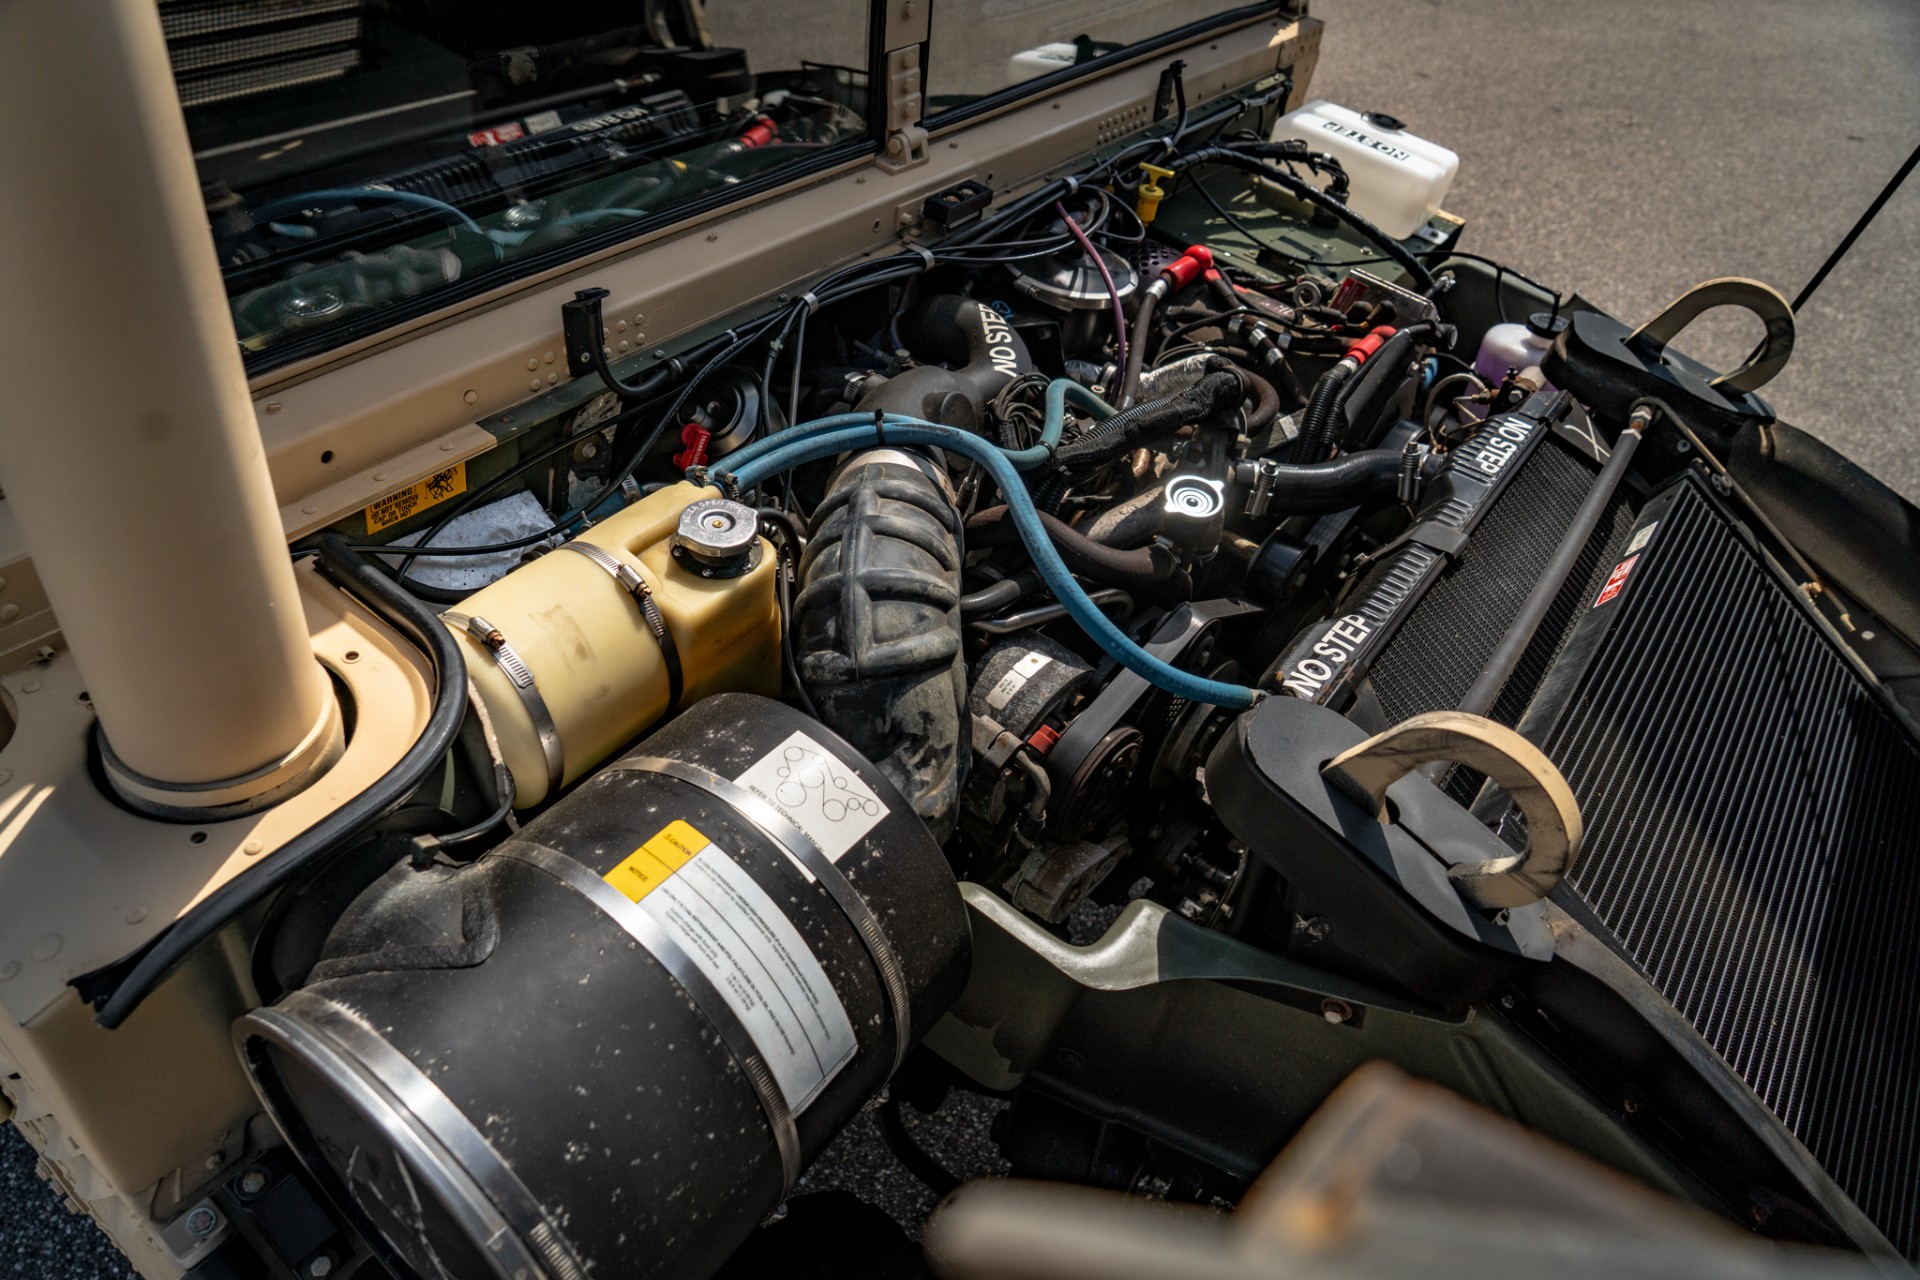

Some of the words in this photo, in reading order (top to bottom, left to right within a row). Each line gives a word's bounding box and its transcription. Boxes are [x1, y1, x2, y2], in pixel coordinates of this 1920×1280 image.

[978, 303, 1012, 344] STEP
[989, 346, 1018, 378] NO
[1498, 417, 1532, 441] NO
[1476, 437, 1517, 474] STEP
[371, 511, 380, 520] DO
[380, 505, 393, 515] NOT
[395, 494, 419, 509] REMOVE
[373, 487, 413, 510] WARNING
[374, 515, 386, 524] CAP
[388, 510, 397, 519] OR
[398, 501, 418, 515] TOUCH
[381, 515, 398, 526] WHEN
[400, 509, 411, 518] HOT
[1282, 659, 1332, 697] NO
[1313, 614, 1371, 662] STEP
[748, 784, 768, 800] REFER
[767, 797, 776, 807] TO
[668, 837, 692, 856] CAUTION
[628, 865, 649, 882] NOTICE
